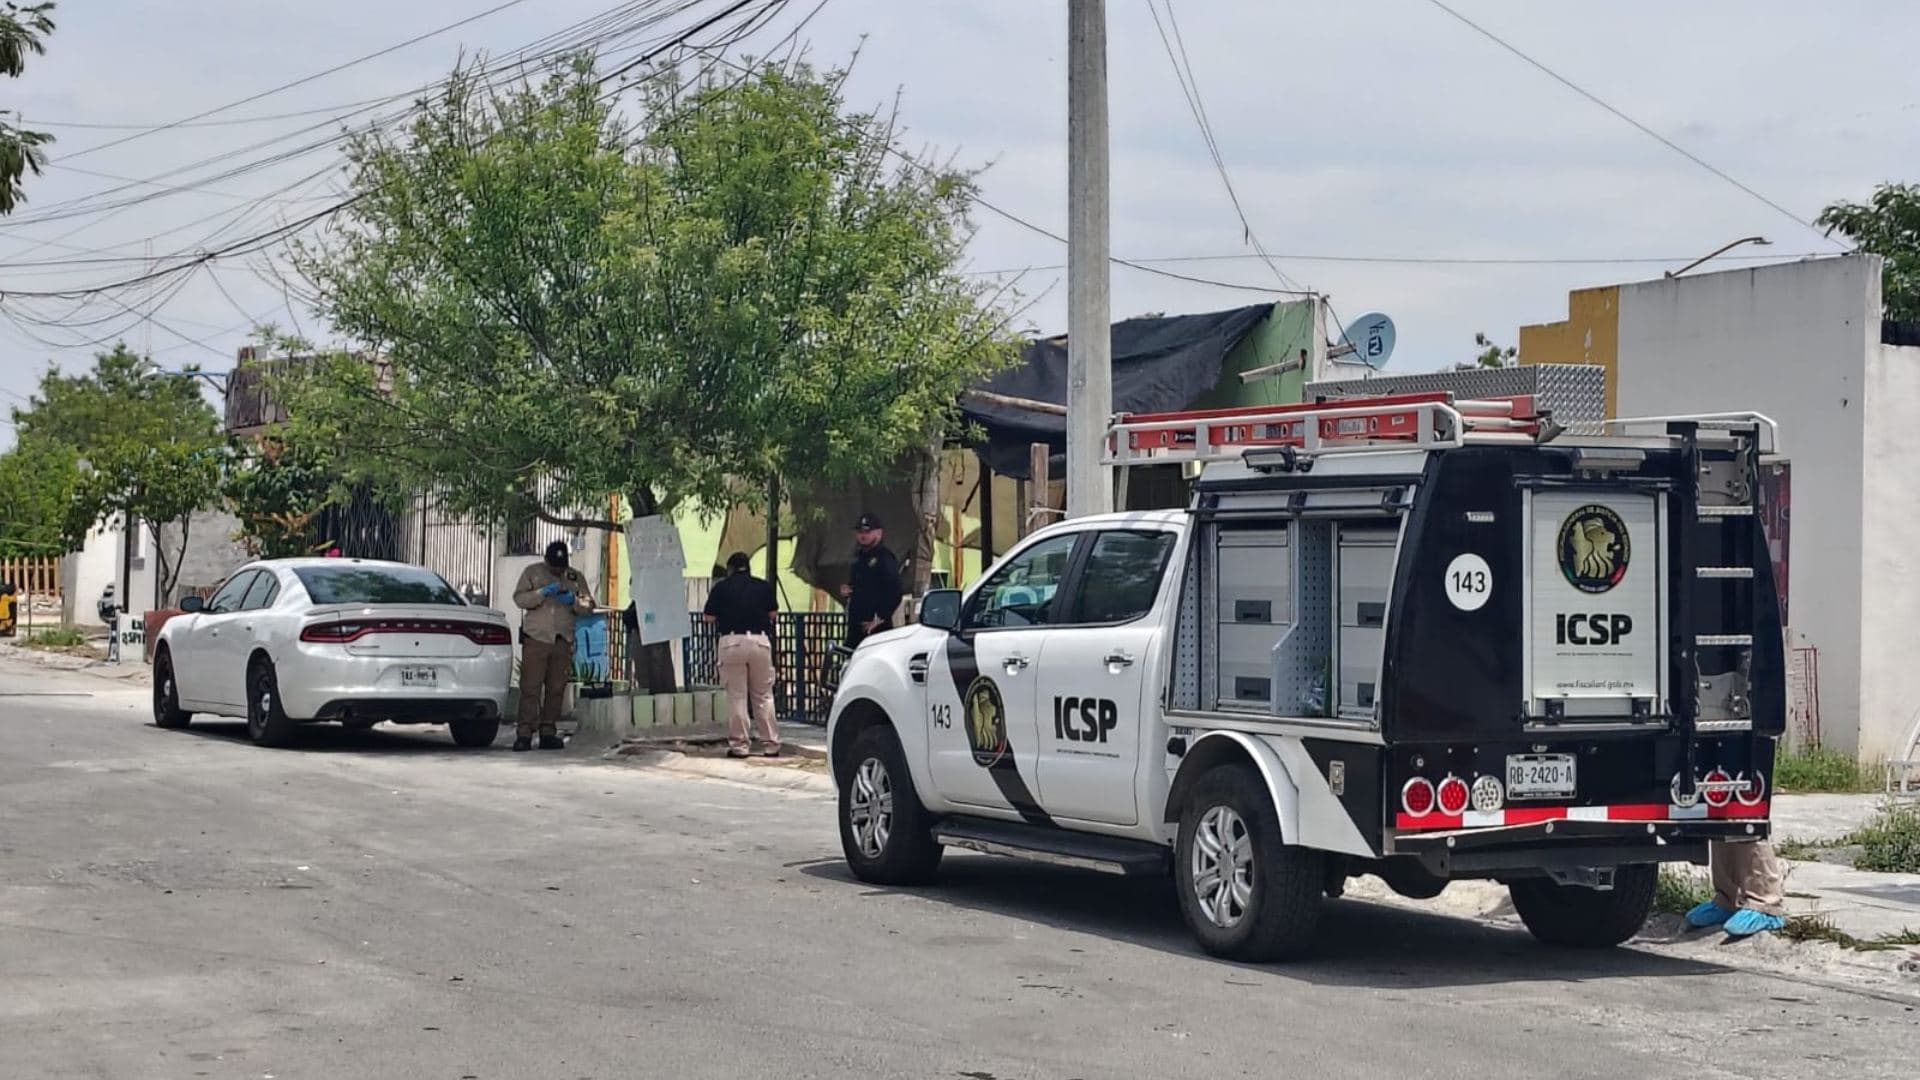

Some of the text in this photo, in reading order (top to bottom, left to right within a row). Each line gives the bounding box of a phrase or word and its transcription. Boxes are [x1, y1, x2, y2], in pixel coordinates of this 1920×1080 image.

[1452, 570, 1486, 593] 143
[1556, 613, 1633, 646] ICSP
[931, 703, 952, 729] 143
[1053, 695, 1118, 744] ICSP
[1510, 765, 1573, 785] RB-2420-A
